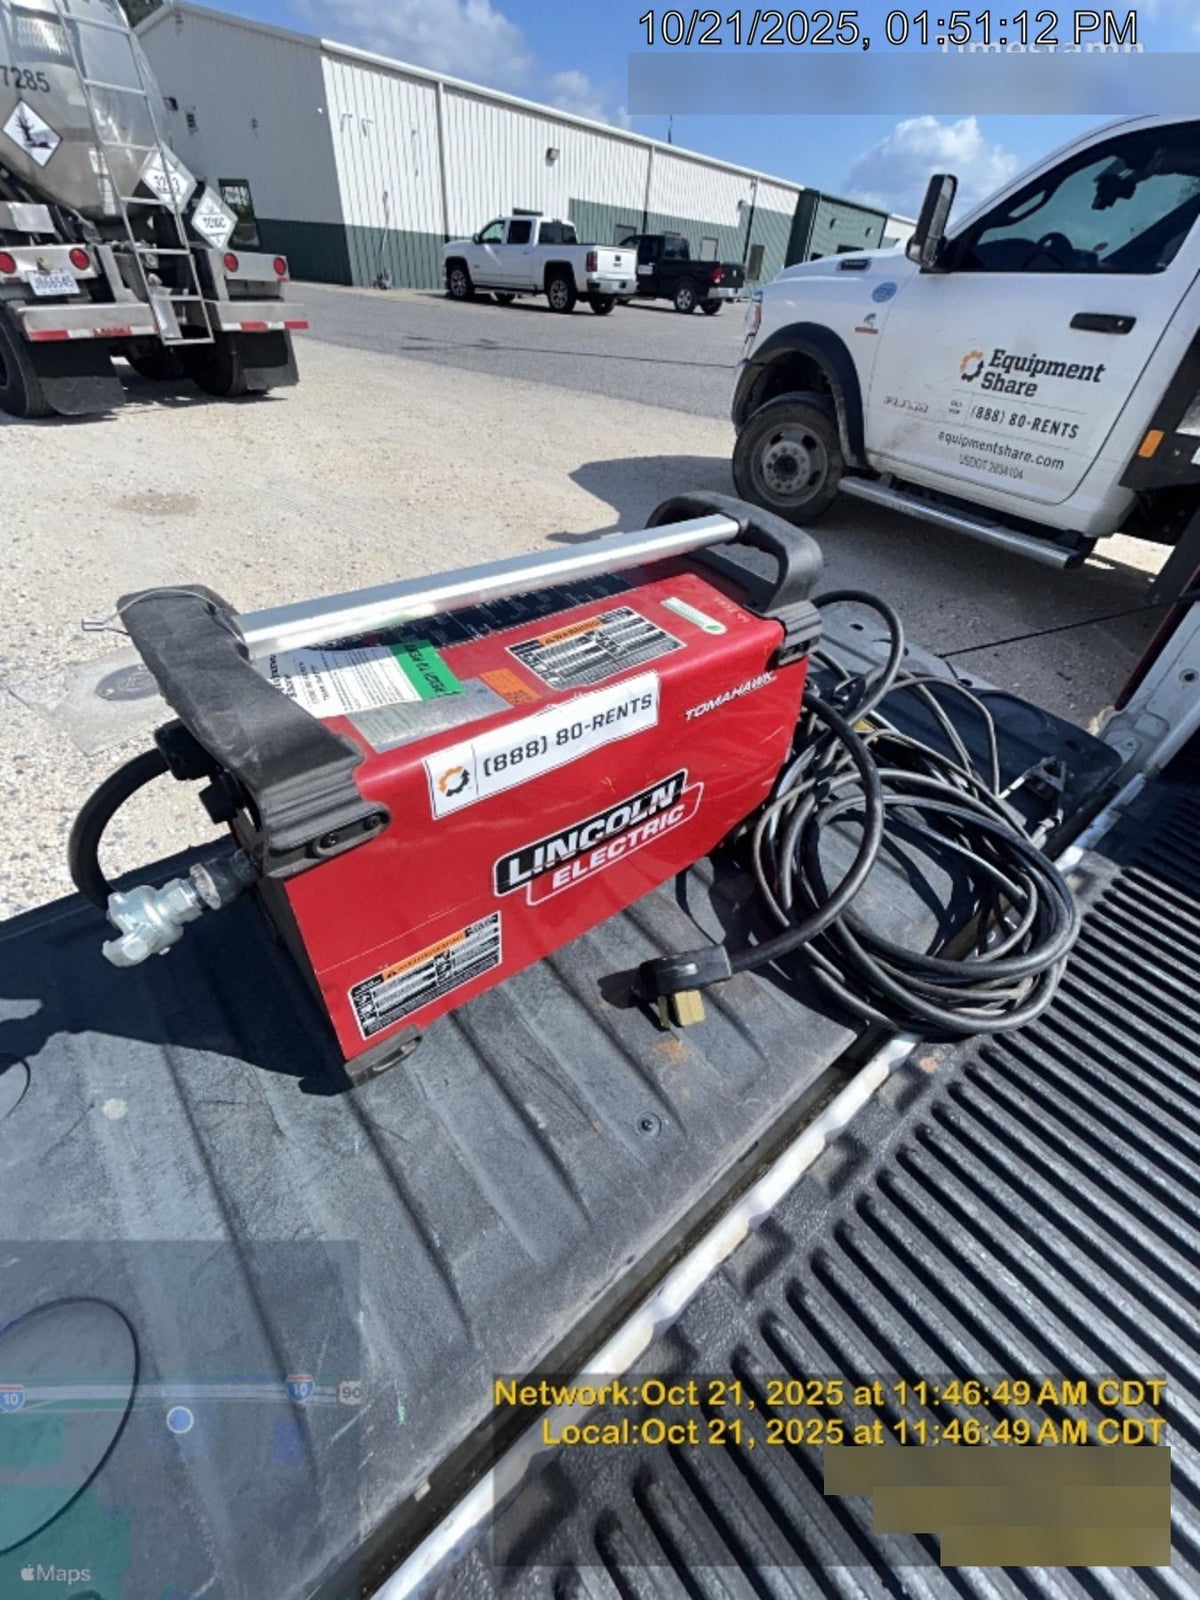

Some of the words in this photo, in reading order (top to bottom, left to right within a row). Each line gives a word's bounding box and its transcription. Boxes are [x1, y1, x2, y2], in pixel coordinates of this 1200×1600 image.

[0, 65, 51, 93] 7285
[981, 371, 1038, 397] Share
[988, 348, 1106, 383] Equipment
[971, 406, 1006, 424] (888)
[1008, 412, 1080, 439] 80-RENTS
[937, 430, 1065, 470] equipmentshare.com
[685, 671, 776, 721] TOMAHAWK
[483, 735, 548, 777] (888)
[555, 693, 653, 746] 80-RENTS
[508, 780, 677, 887] LINCOLN
[552, 803, 685, 890] ELECTRIC
